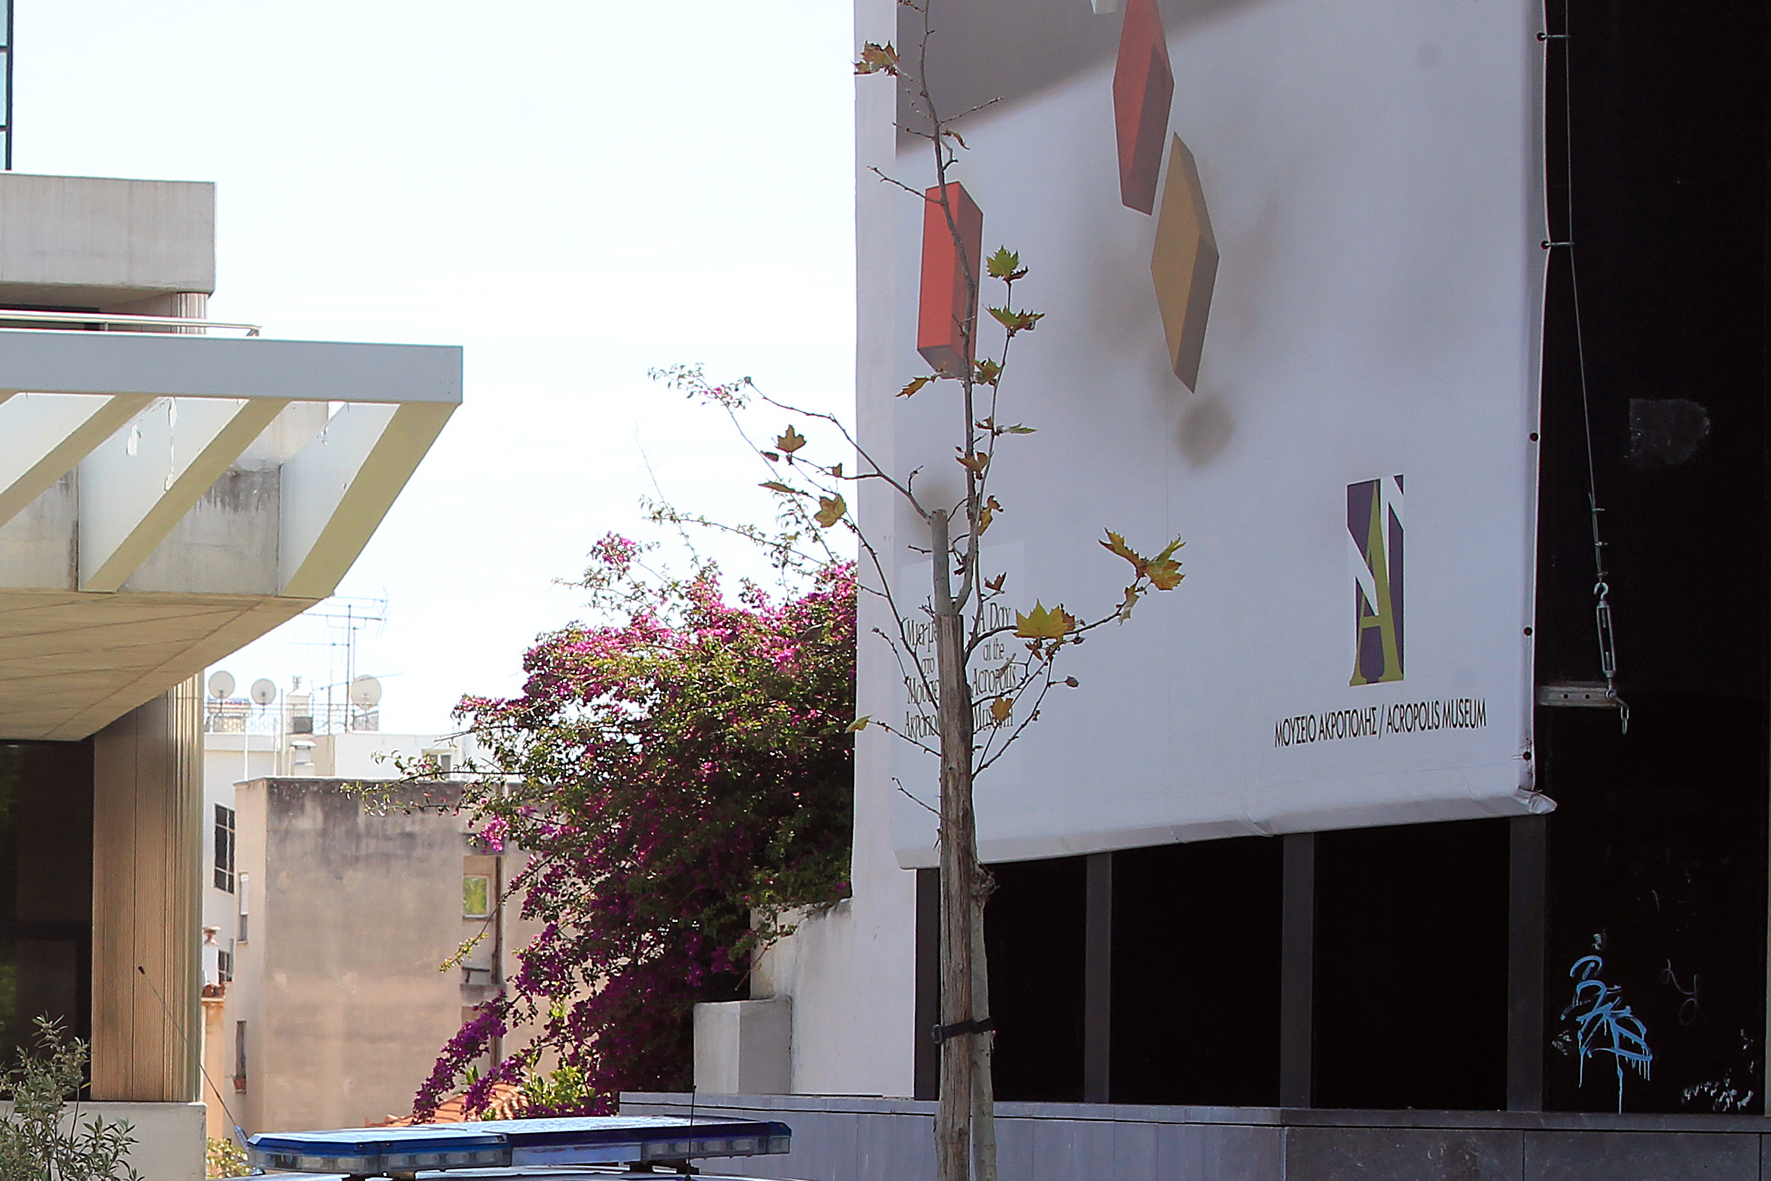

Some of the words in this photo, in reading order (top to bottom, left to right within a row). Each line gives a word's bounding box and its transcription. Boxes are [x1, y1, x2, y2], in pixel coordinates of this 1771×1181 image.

[1275, 714, 1317, 748] ΜΟΥΣΕΙΟ
[1318, 707, 1377, 741] ΑΚΡΟΠΟΛΗΣ
[1386, 699, 1440, 733] ACROPOLIS
[1442, 697, 1487, 728] MUSEUM
